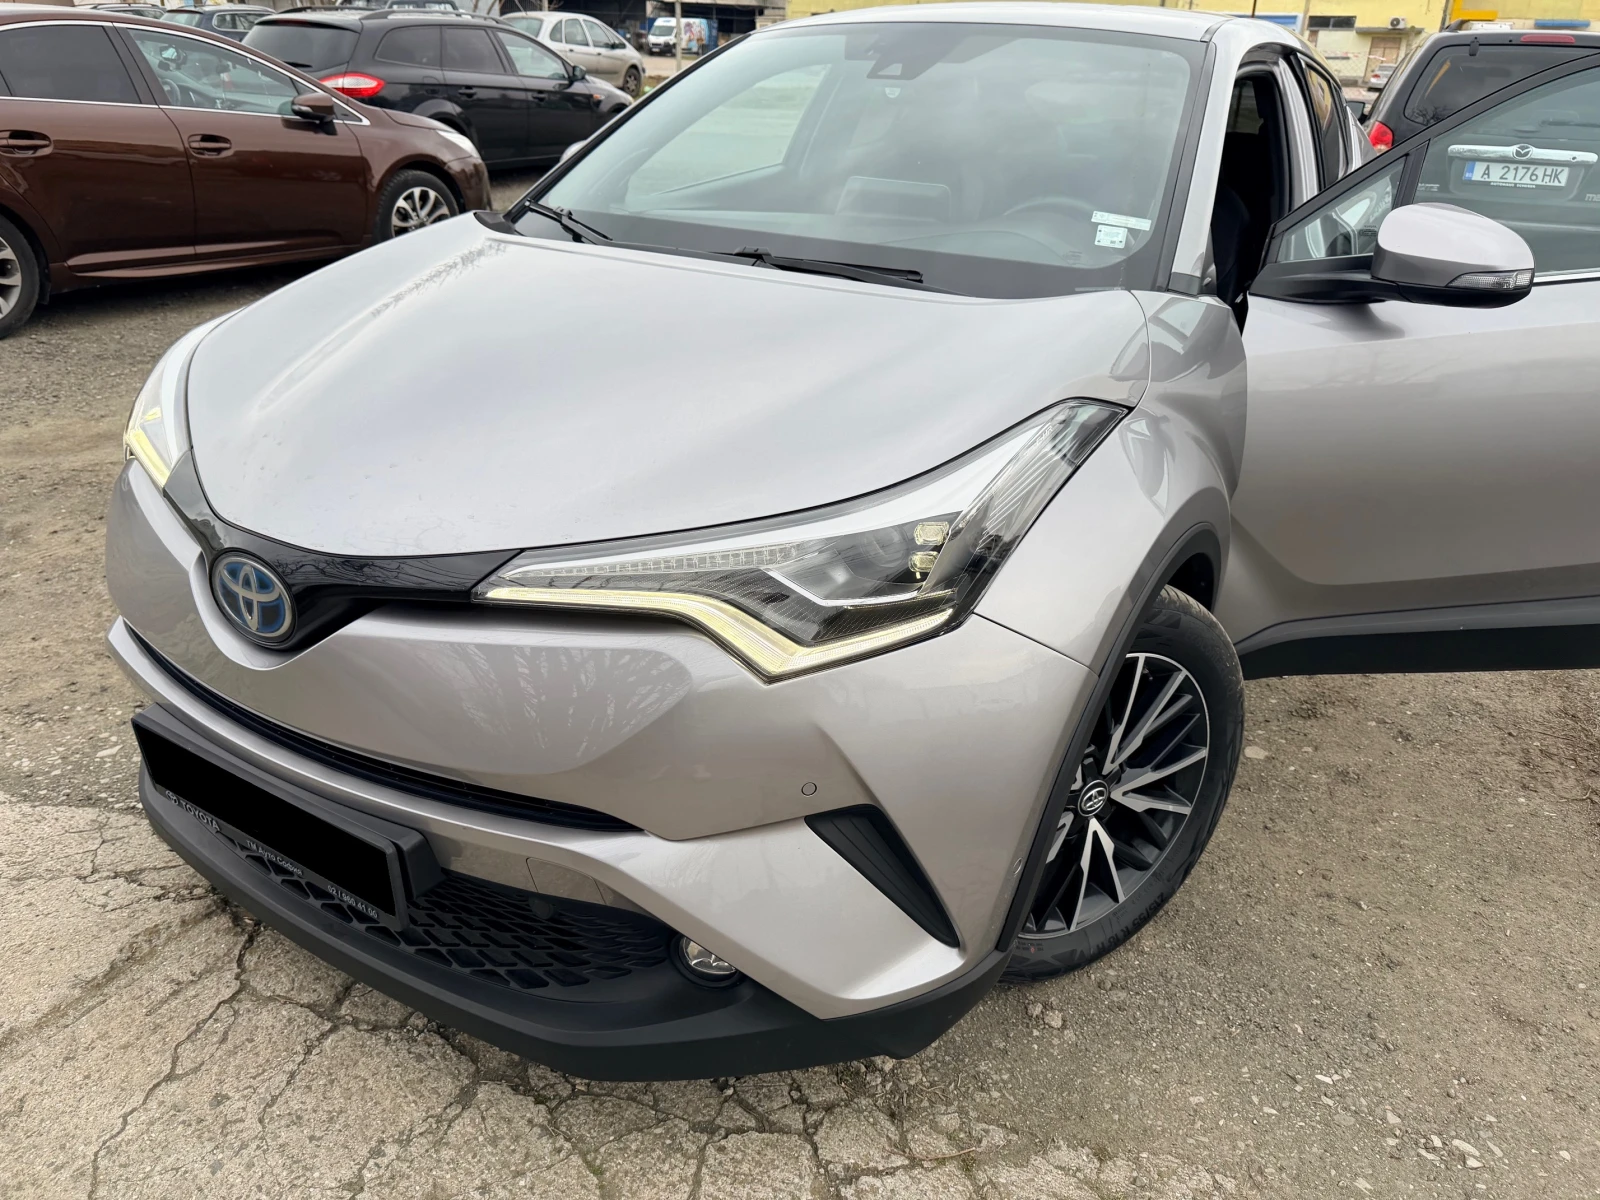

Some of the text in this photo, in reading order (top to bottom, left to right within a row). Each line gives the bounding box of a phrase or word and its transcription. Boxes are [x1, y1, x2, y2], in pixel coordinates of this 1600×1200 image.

[1481, 164, 1565, 184] A 2176 HK
[180, 799, 220, 831] TOYOTA
